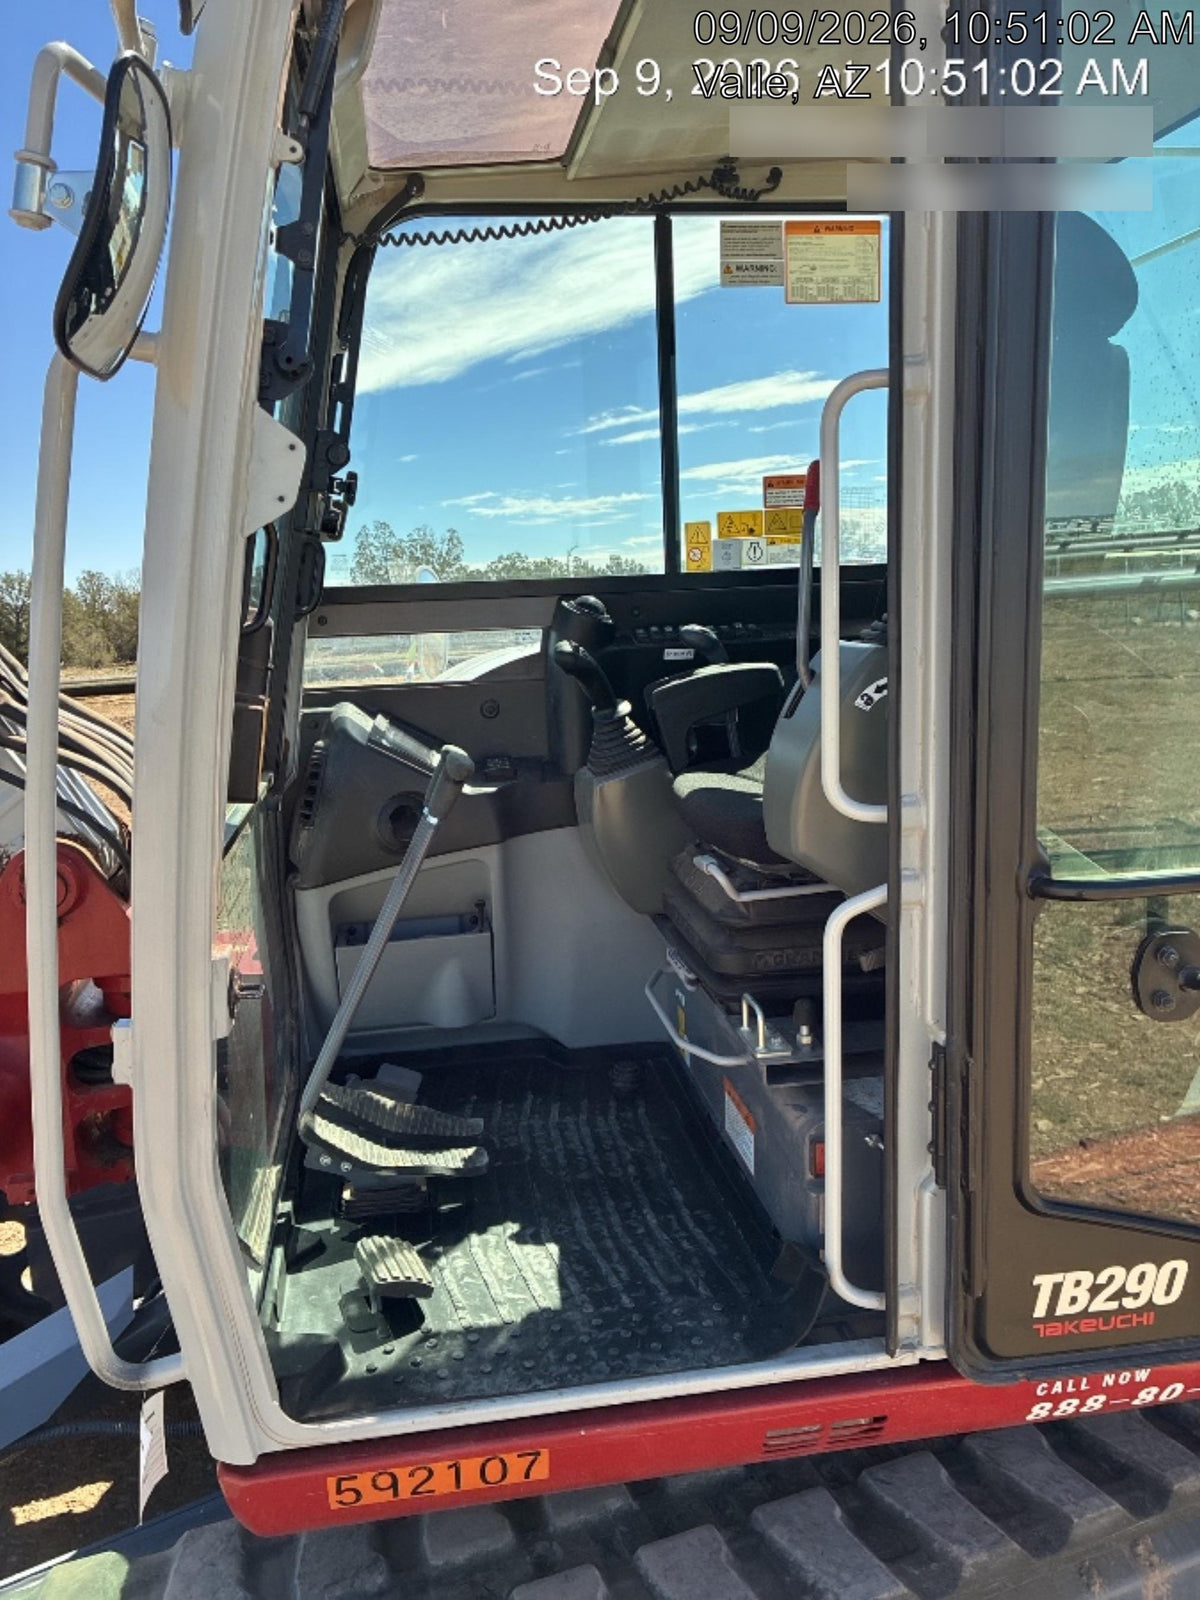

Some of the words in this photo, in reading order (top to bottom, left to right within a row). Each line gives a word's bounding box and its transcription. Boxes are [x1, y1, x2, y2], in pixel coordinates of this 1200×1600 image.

[1032, 1259, 1189, 1318] TB290
[1036, 1377, 1091, 1396] CALL
[1101, 1368, 1152, 1388] NOW
[334, 1450, 542, 1506] 592107
